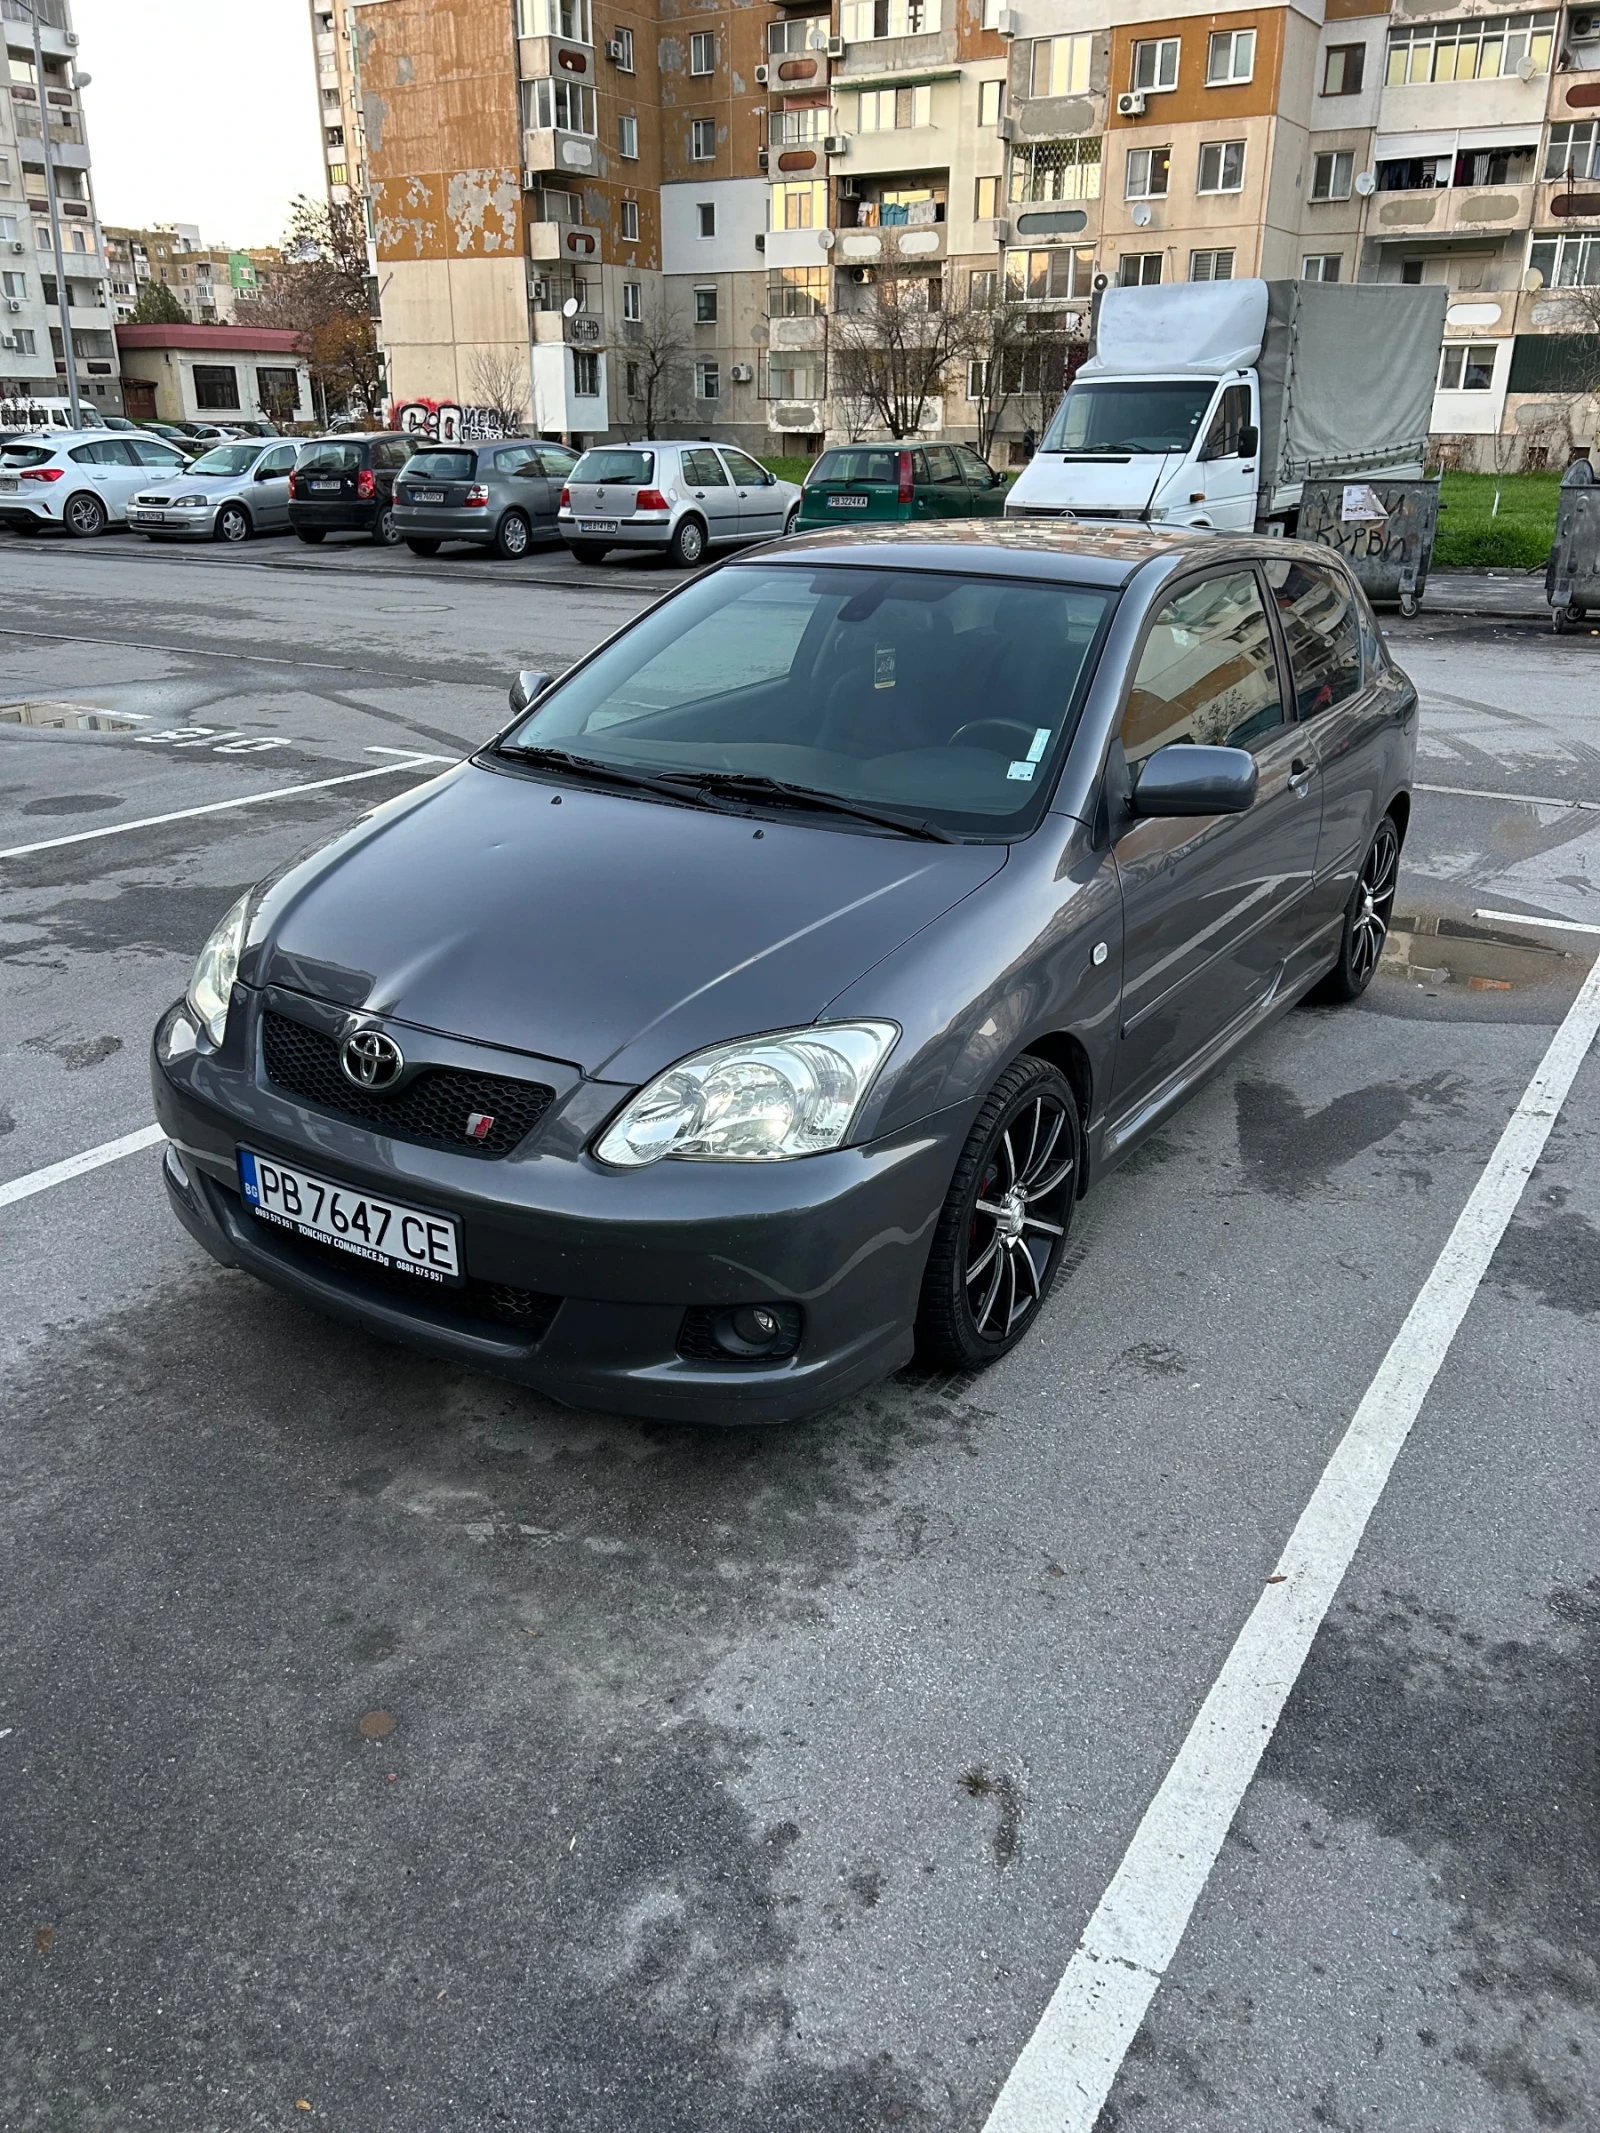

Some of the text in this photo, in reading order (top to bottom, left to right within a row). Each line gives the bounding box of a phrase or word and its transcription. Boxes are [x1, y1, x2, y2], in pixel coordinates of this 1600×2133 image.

[831, 496, 866, 506] PB 3224 KA
[245, 1182, 258, 1198] BG
[259, 1163, 453, 1271] PB 7647 CE
[415, 1266, 429, 1278] 575
[429, 1271, 443, 1283] 951
